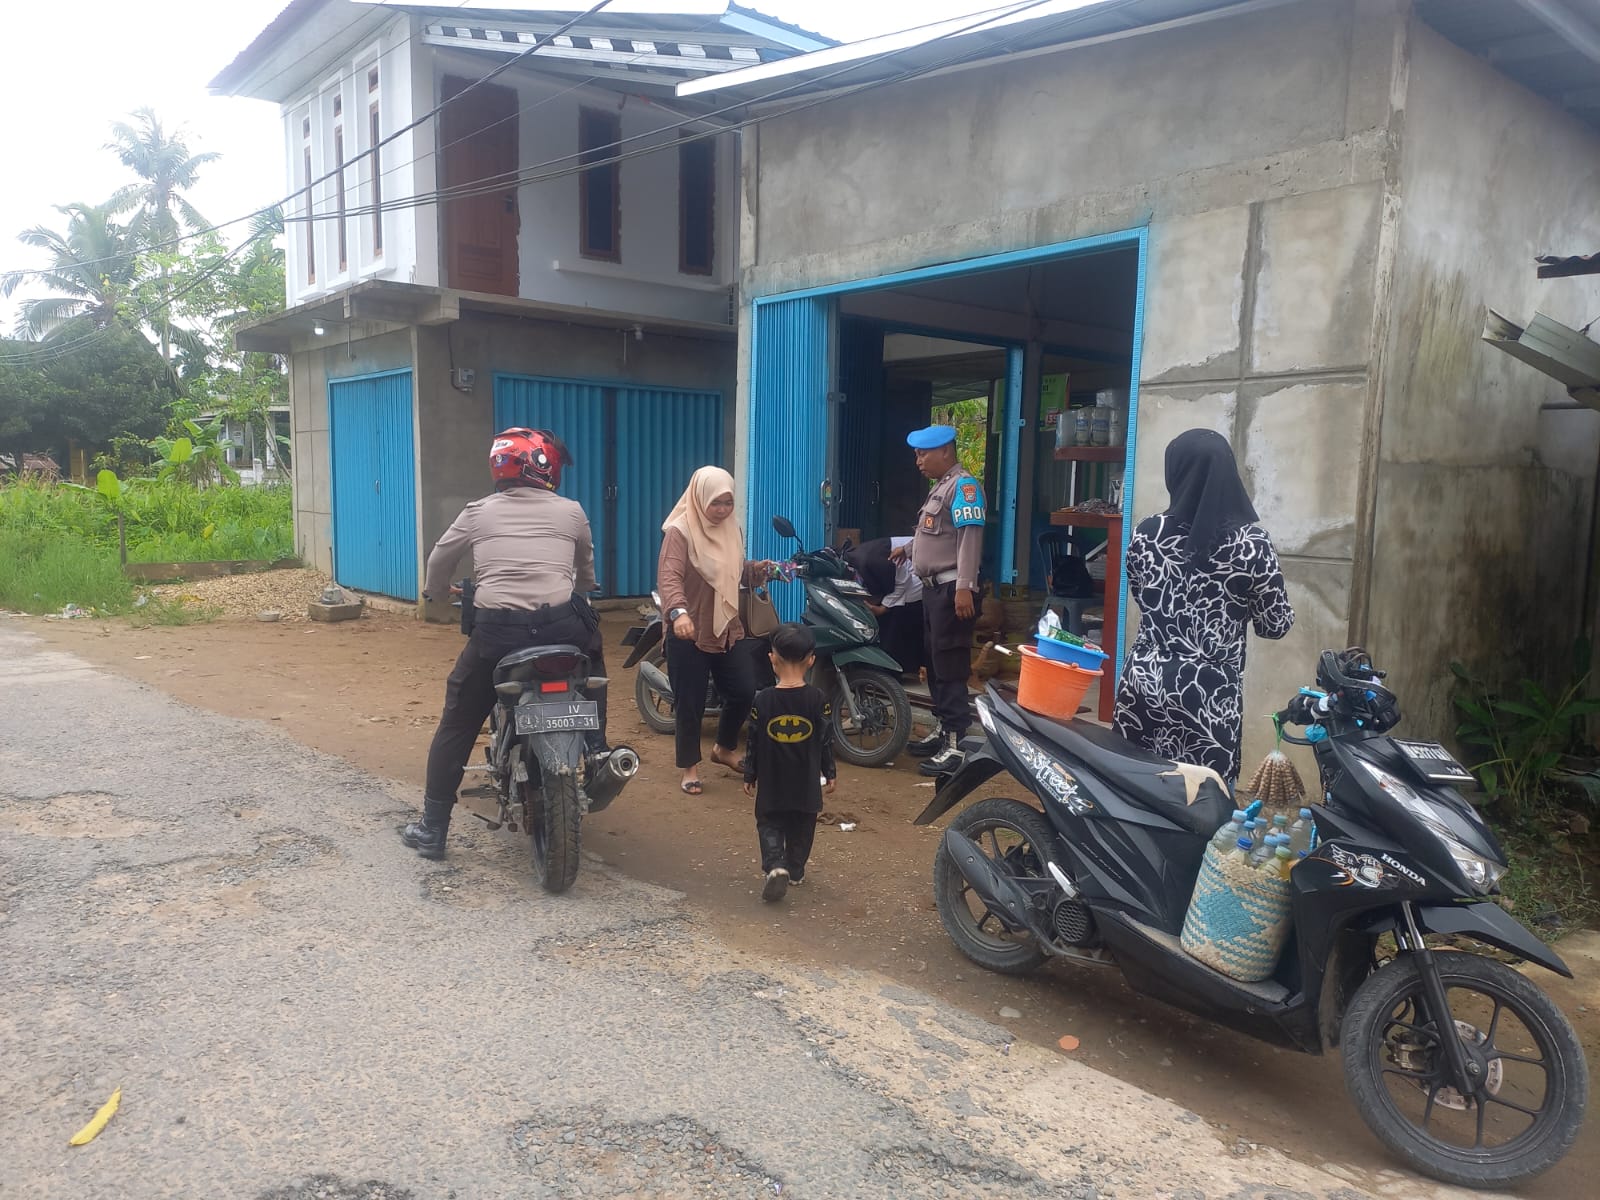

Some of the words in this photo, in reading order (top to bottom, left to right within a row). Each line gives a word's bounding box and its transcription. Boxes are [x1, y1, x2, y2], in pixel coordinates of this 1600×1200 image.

[954, 506, 986, 522] PRO
[568, 704, 580, 714] IV
[1380, 852, 1426, 887] HONDA
